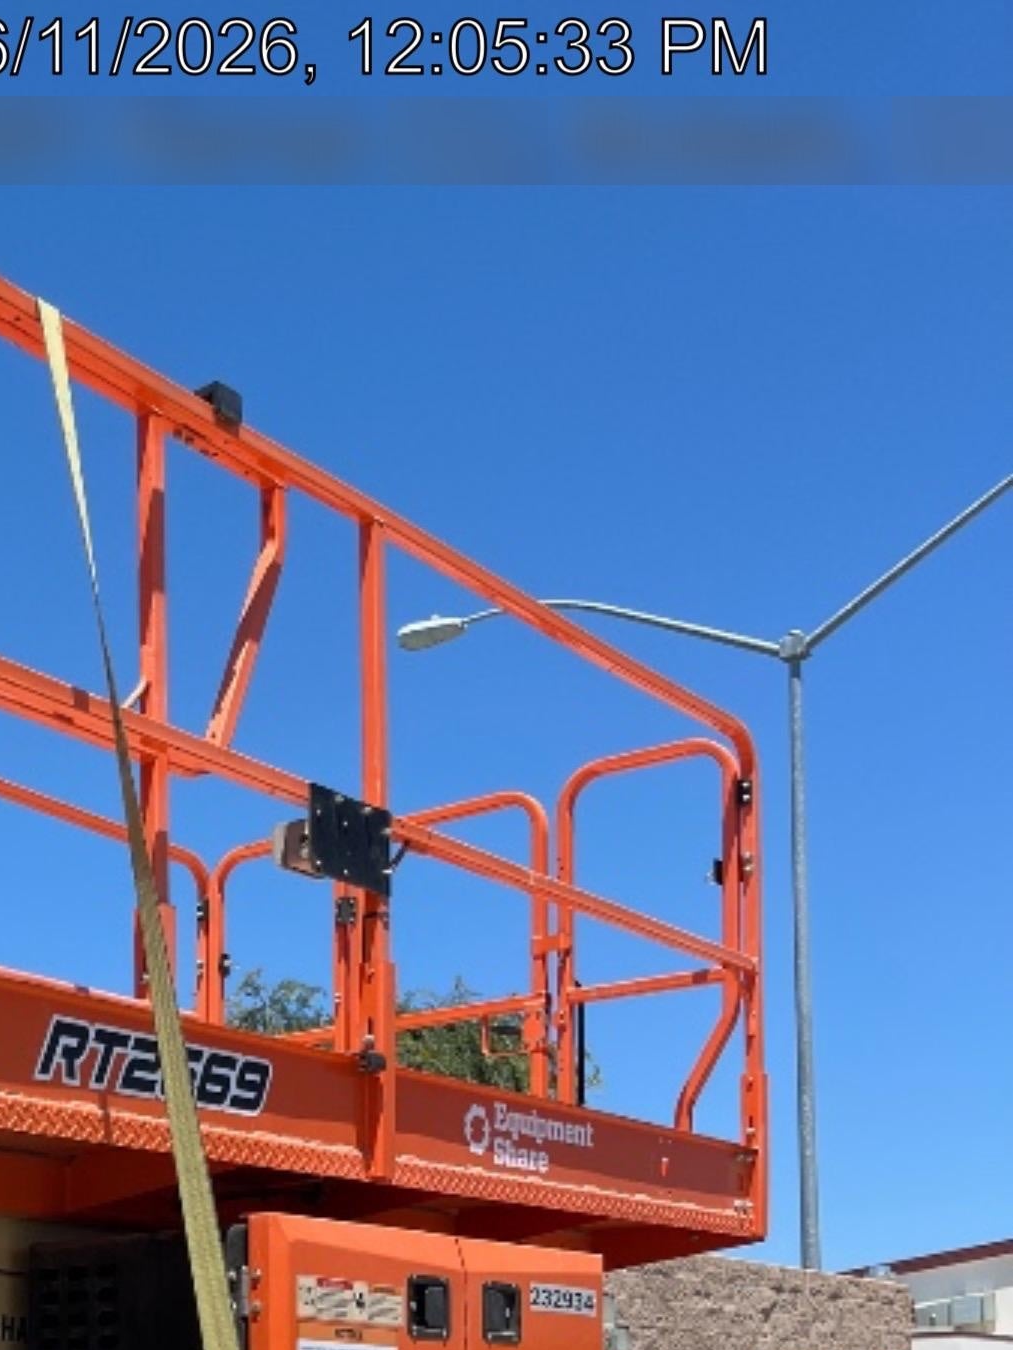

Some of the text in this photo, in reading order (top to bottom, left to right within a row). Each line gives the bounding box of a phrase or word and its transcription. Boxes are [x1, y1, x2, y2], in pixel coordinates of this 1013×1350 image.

[34, 1014, 273, 1117] RT269
[493, 1101, 595, 1147] Equipment
[493, 1136, 550, 1174] Share
